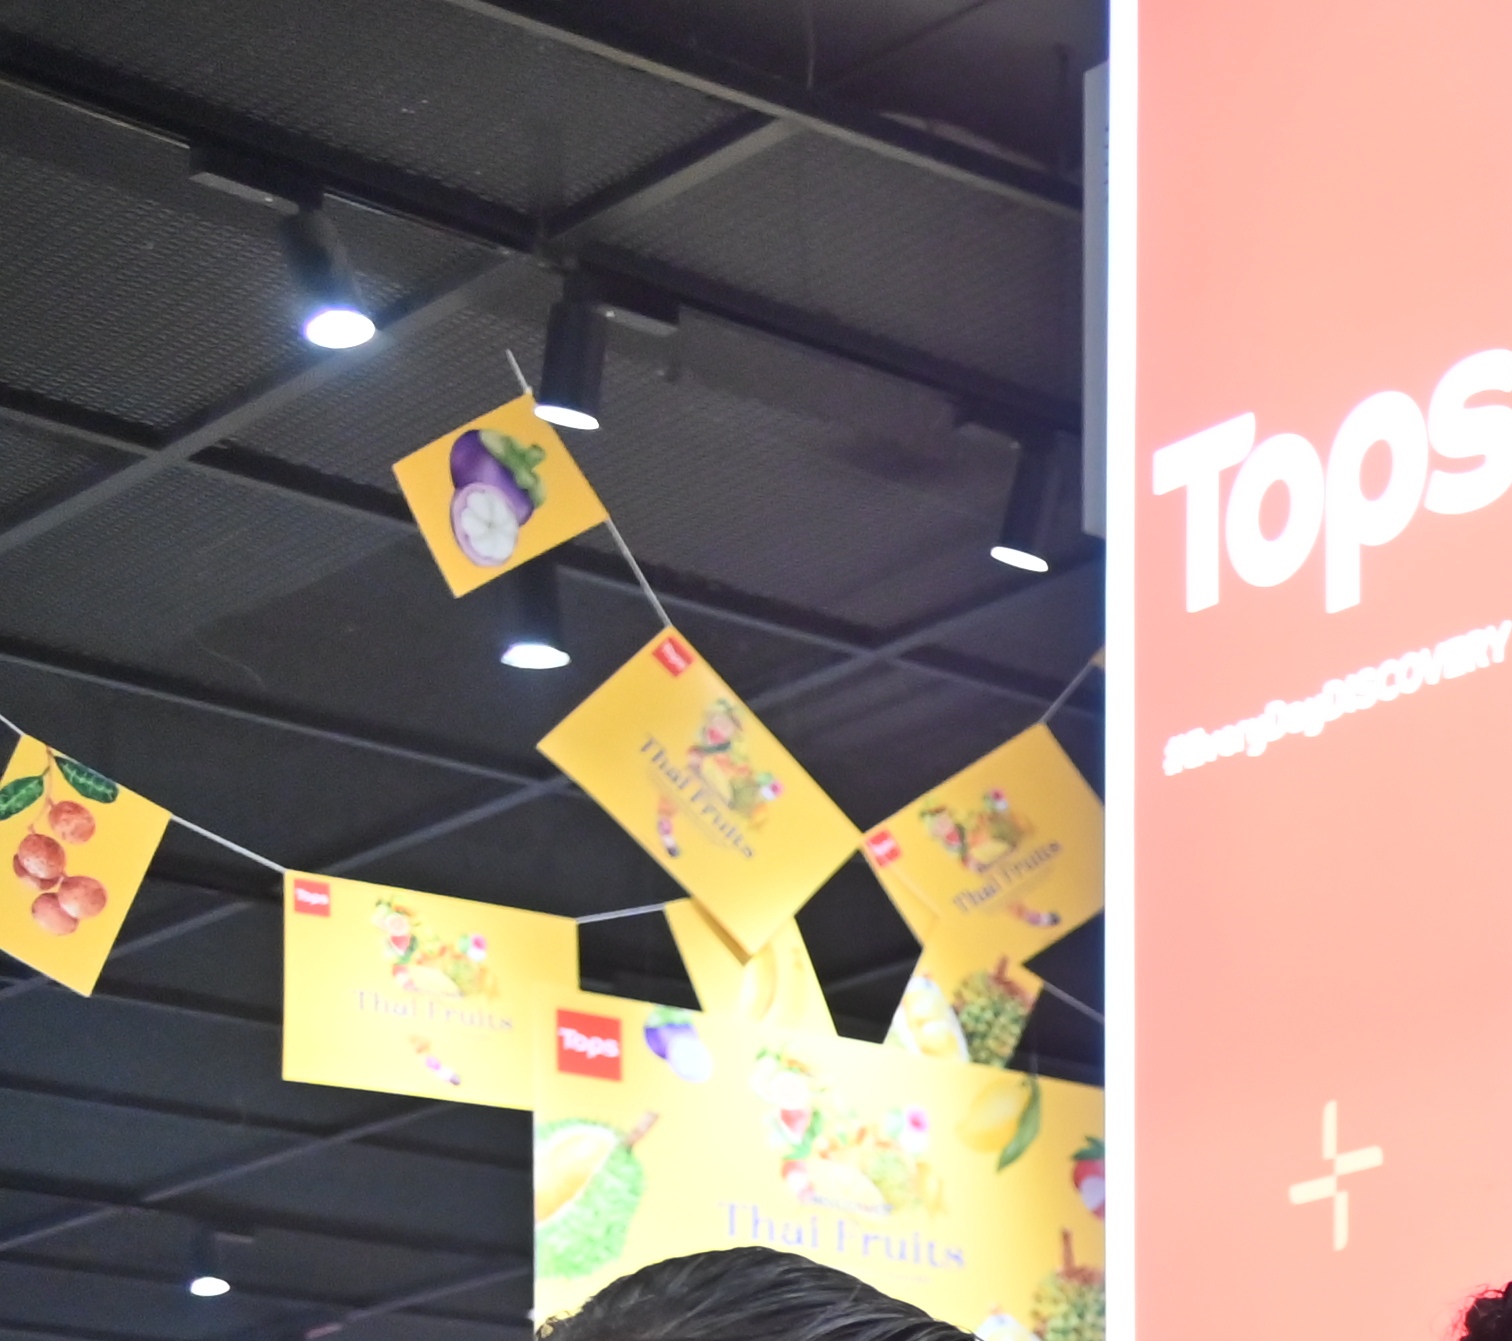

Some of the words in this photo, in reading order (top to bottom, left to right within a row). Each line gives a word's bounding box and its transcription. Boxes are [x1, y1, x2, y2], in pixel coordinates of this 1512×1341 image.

[353, 989, 416, 1016] Thai
[425, 1000, 514, 1031] Fruits
[557, 1027, 620, 1060] Tops
[718, 1202, 820, 1250] Thai
[835, 1218, 966, 1269] Fruits
